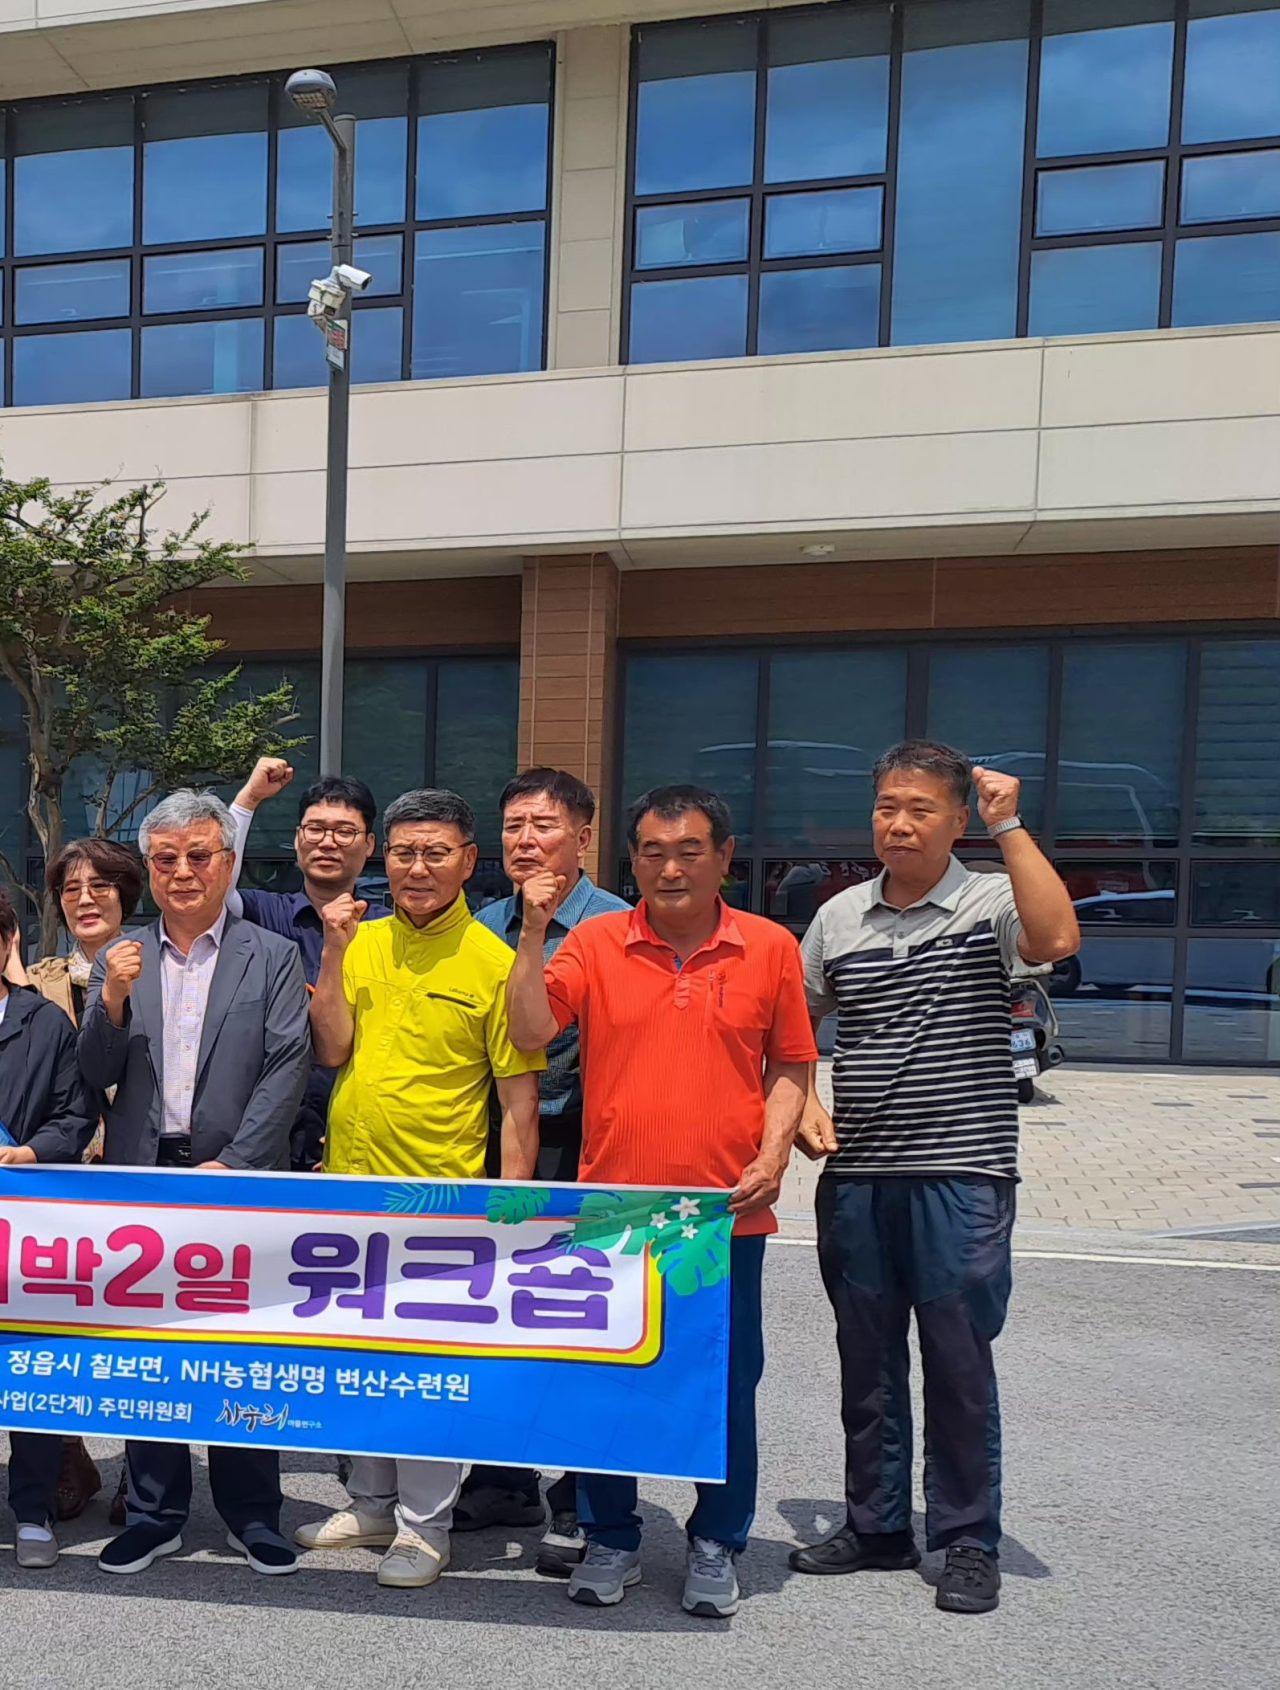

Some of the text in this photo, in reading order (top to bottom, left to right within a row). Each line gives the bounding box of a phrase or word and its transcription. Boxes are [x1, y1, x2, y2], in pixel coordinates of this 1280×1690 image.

[287, 1231, 615, 1331] 워크숍
[6, 1349, 81, 1377] 정읍시
[89, 1352, 170, 1384] 칠보면,
[180, 1358, 325, 1394] NH농협생명
[335, 1367, 470, 1402] 변산수련원
[97, 1396, 192, 1423] 주민위원회
